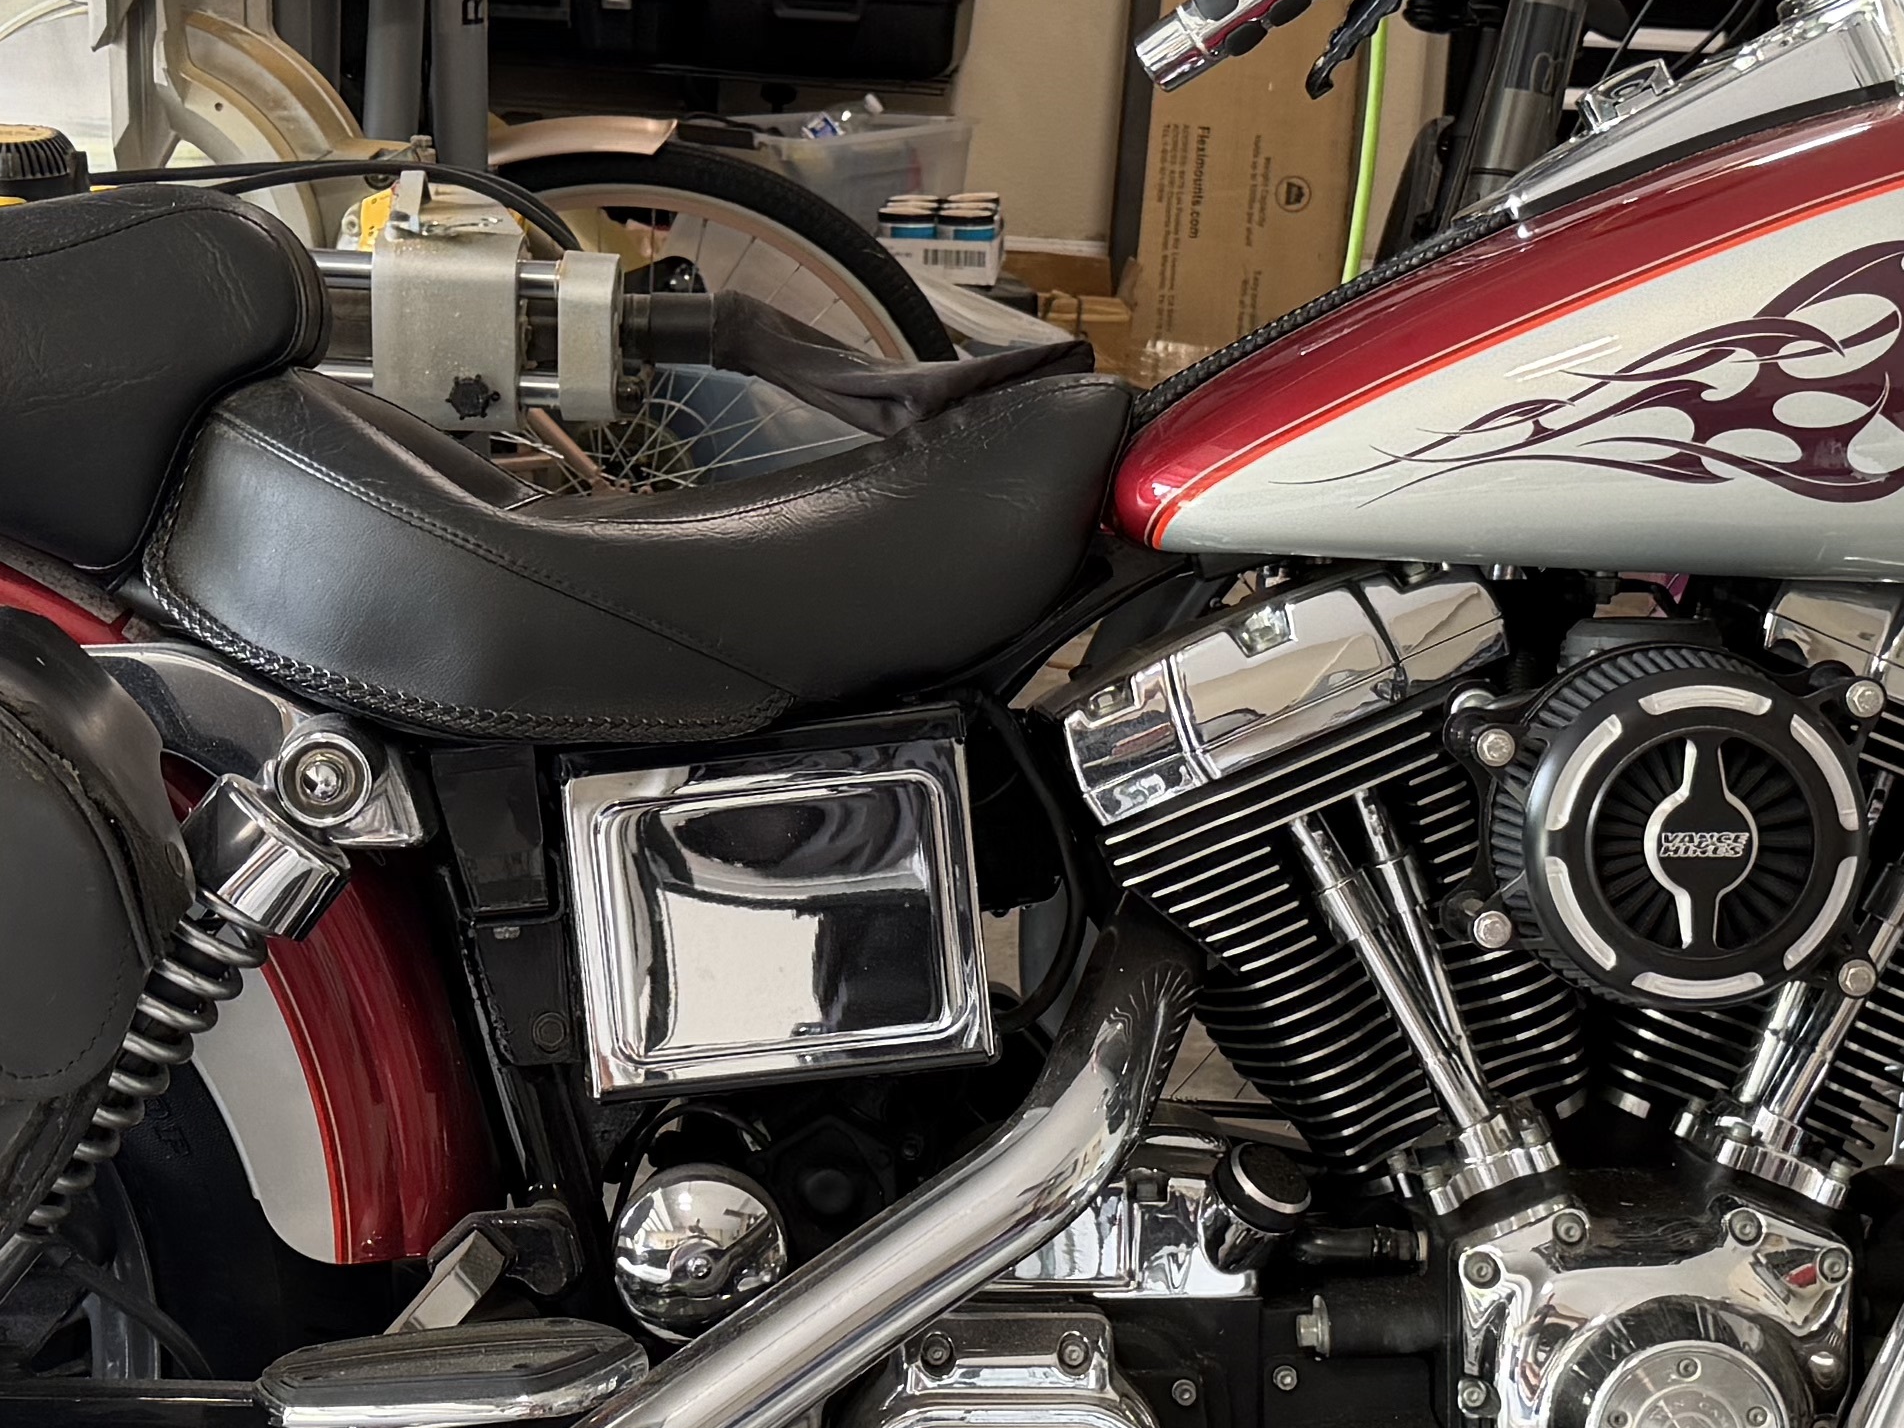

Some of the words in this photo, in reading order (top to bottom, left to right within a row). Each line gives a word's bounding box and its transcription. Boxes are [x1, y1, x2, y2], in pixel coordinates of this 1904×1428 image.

[1189, 126, 1211, 239] Fleximounts.com
[1661, 832, 1750, 846] VANCE
[1659, 843, 1745, 858] HINES
